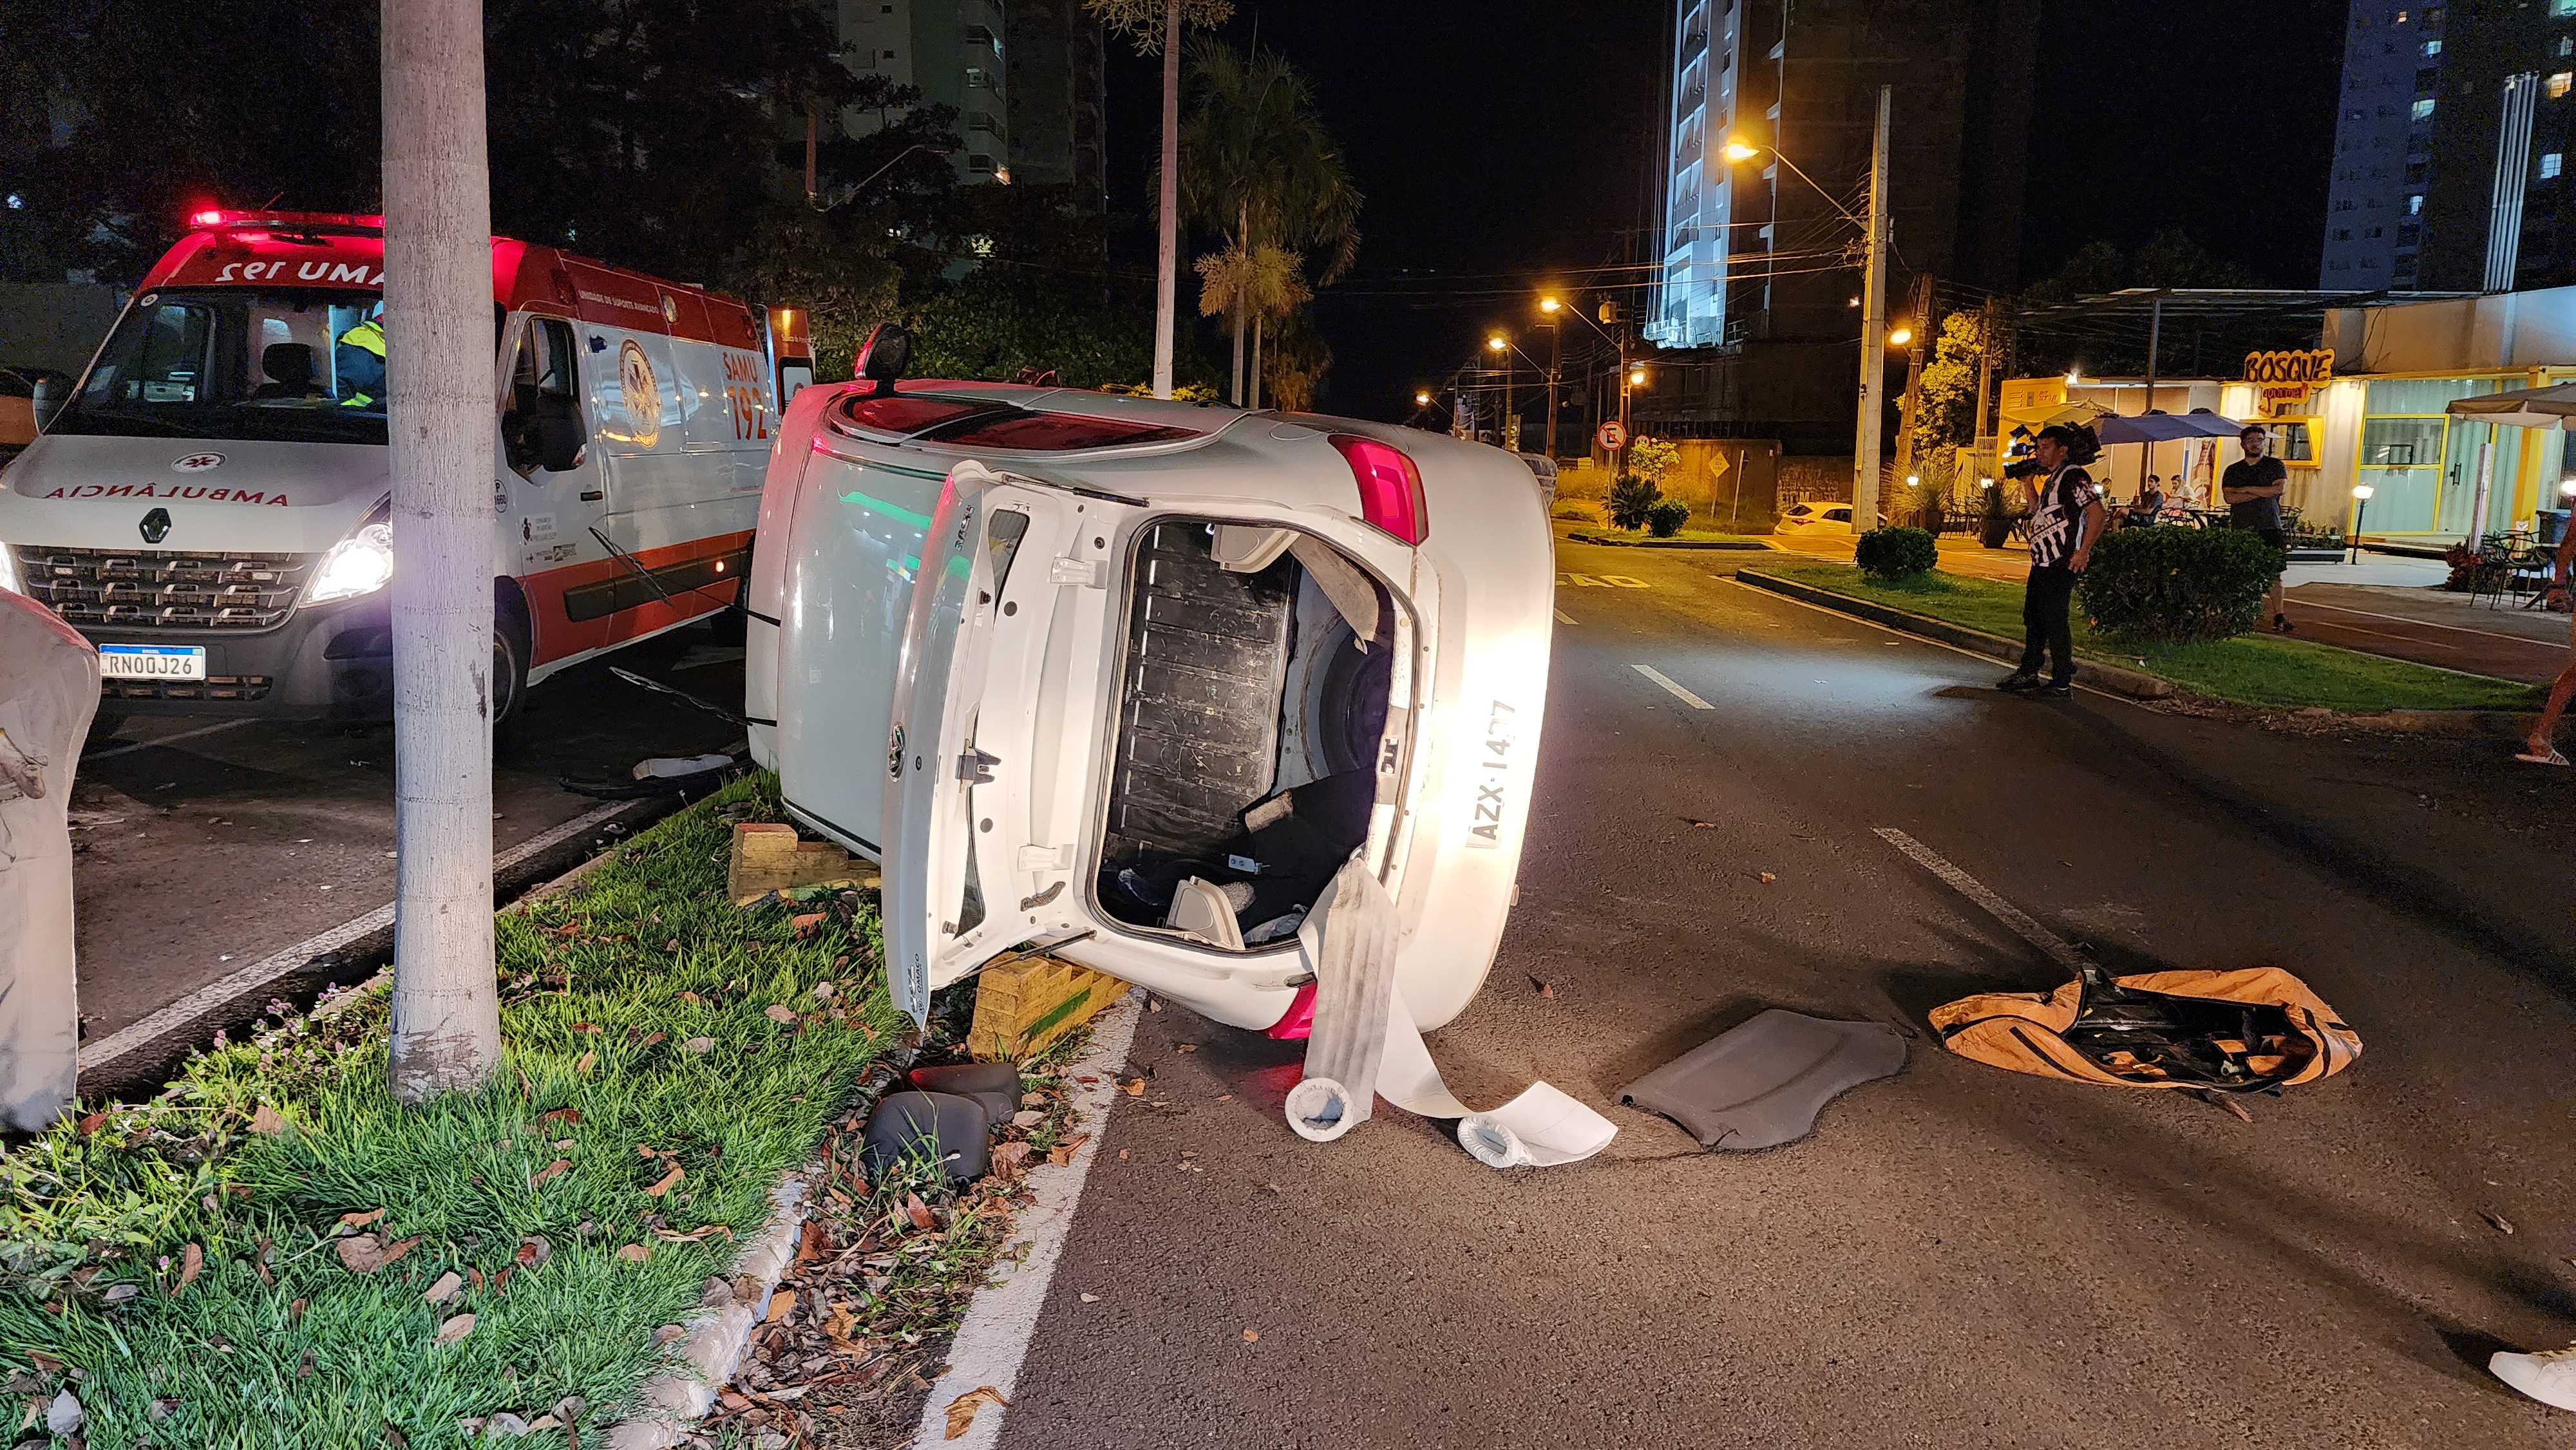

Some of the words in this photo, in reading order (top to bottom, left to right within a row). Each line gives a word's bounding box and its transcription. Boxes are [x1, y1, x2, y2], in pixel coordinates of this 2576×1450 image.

[723, 352, 758, 383] SAMU
[2244, 354, 2332, 382] BOSQUE
[728, 385, 768, 441] 192
